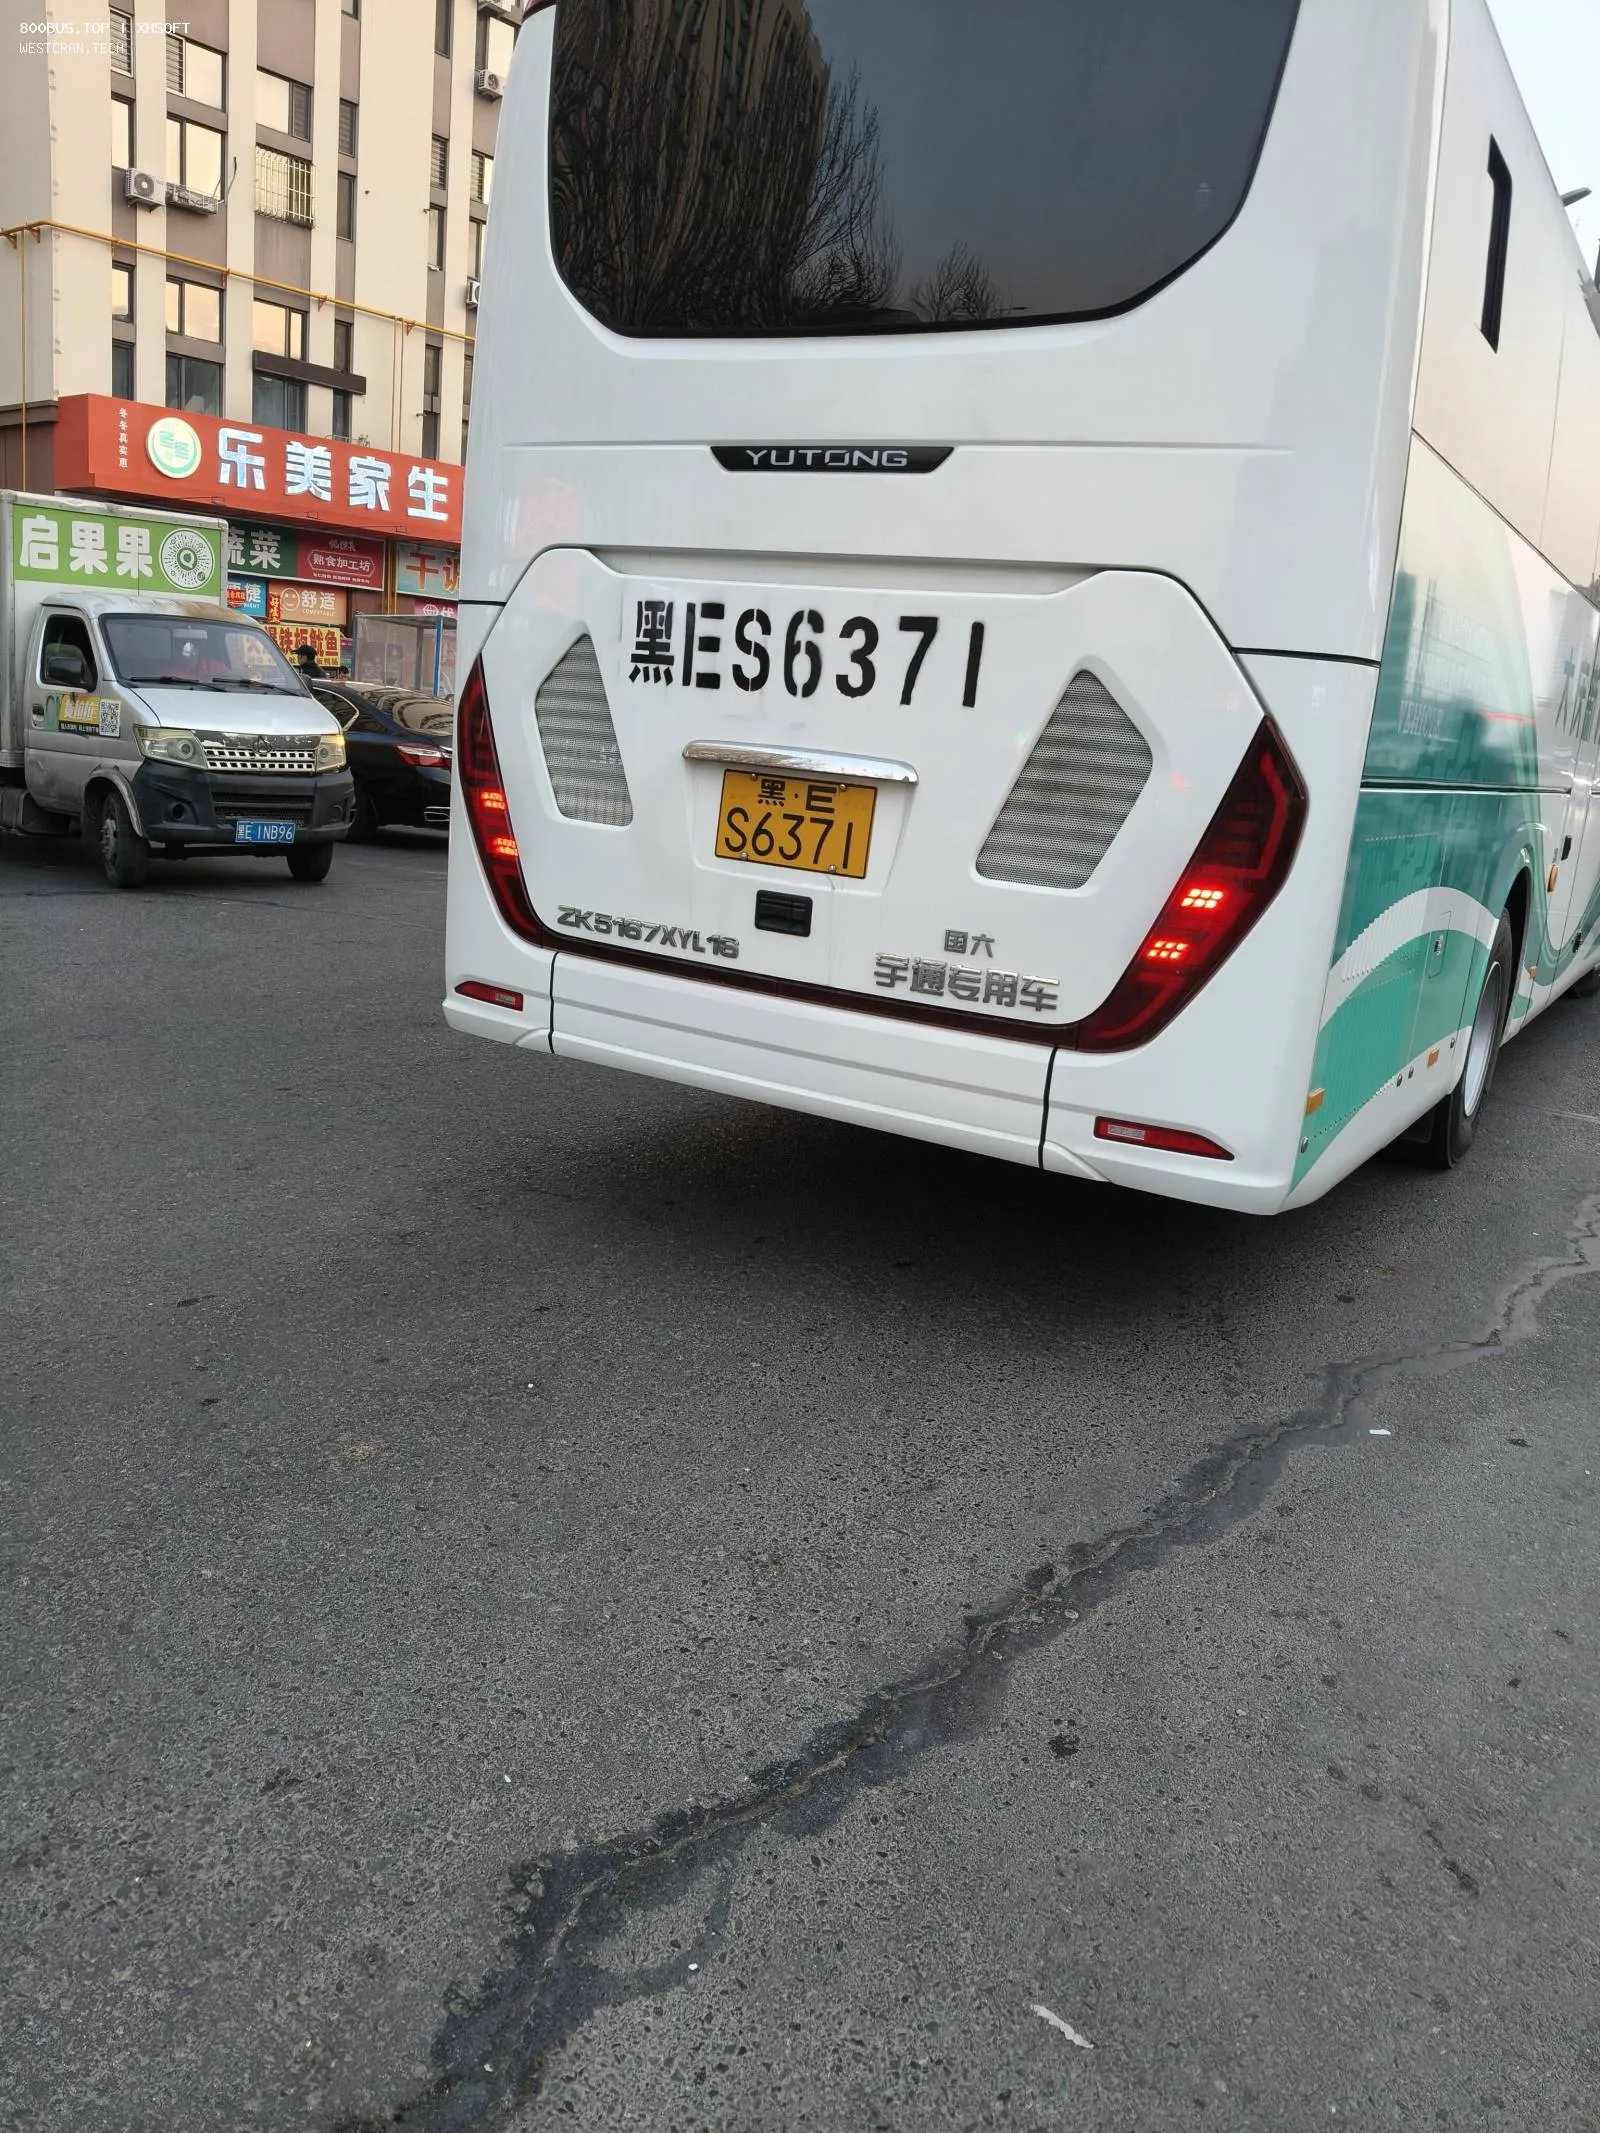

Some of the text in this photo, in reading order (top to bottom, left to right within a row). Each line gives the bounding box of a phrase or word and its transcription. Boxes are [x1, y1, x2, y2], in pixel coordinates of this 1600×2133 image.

[218, 427, 449, 522] 乐美家生
[746, 449, 908, 467] YUTONG
[20, 514, 153, 578] 启果果
[313, 552, 371, 572] 熟食加工坊
[301, 589, 336, 610] 舒适
[628, 600, 985, 708] 黑ES6371
[724, 807, 853, 870] S6371
[556, 905, 740, 959] ZK5167XYL16
[943, 930, 996, 958] 国六
[873, 952, 1060, 1012] 宇通专用车
